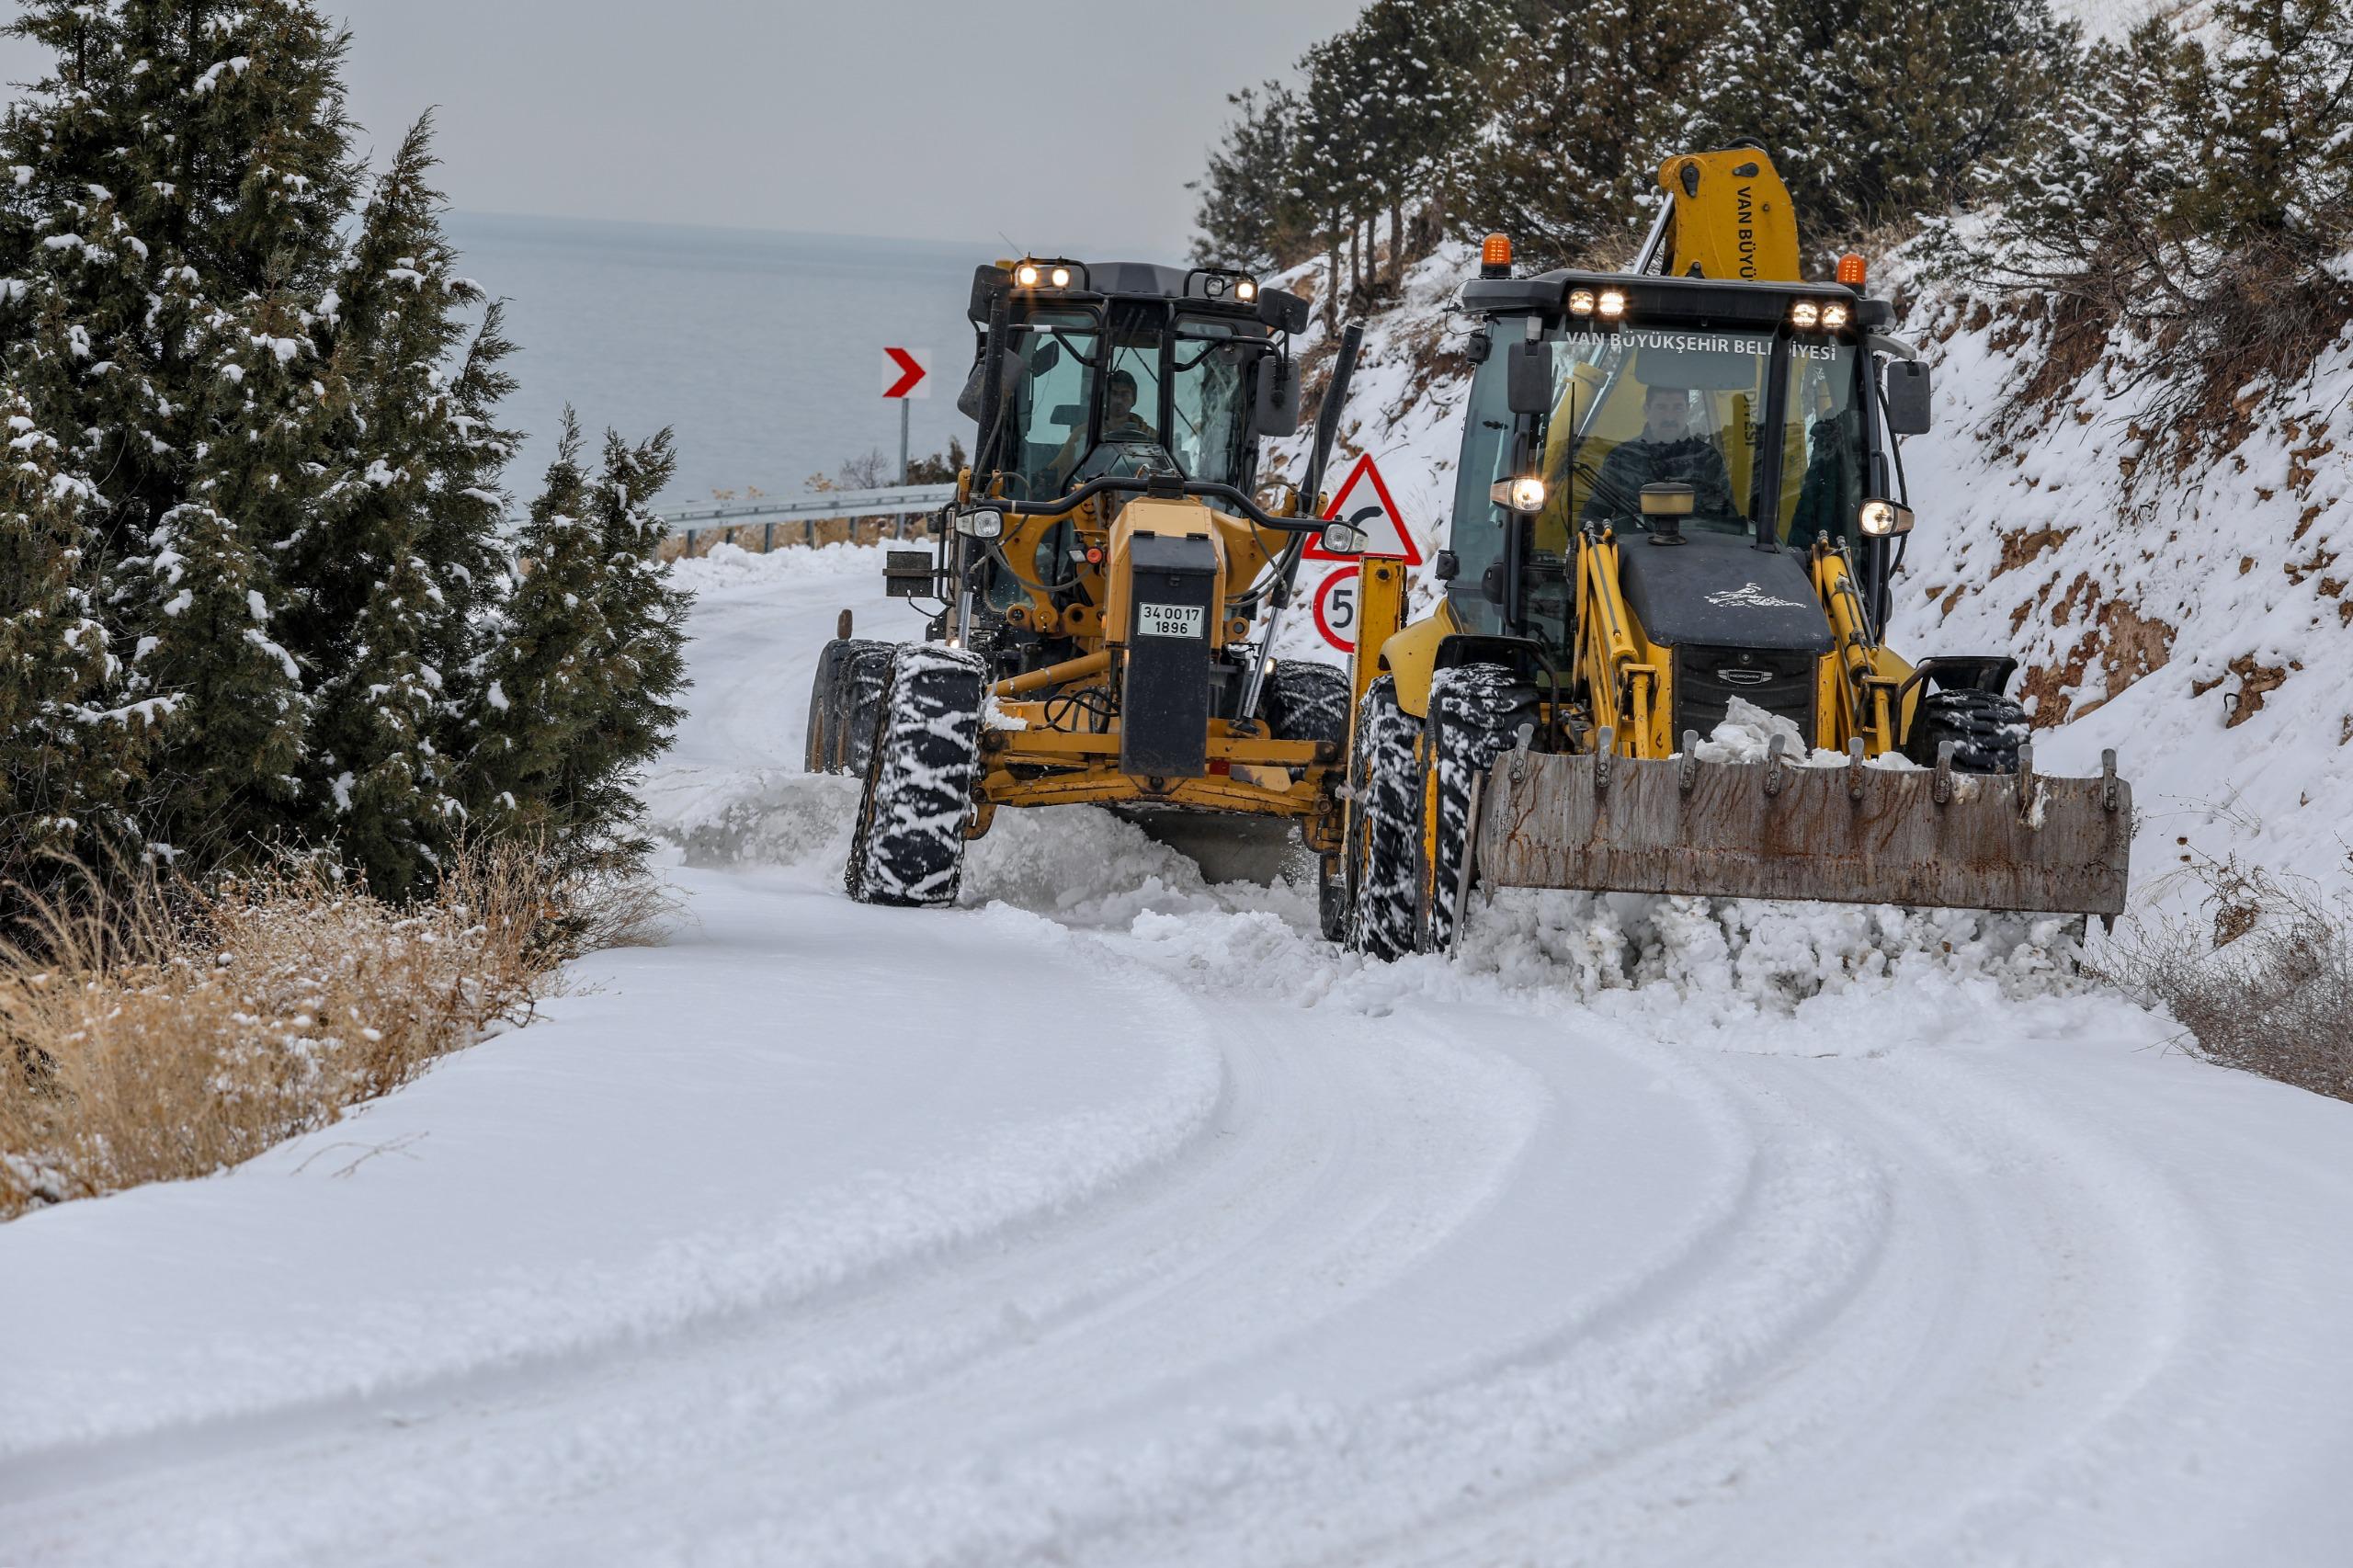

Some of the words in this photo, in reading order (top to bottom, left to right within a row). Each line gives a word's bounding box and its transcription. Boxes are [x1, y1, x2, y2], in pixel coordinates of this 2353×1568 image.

[1737, 186, 1752, 224] VAN
[1738, 228, 1756, 281] BÜYÜ
[1565, 331, 1605, 347] VAN
[1610, 330, 1729, 354] BÜYÜKŞEHİR
[1733, 339, 1836, 361] BELİYESİ
[1143, 606, 1161, 619] 34
[1155, 620, 1188, 635] 1896
